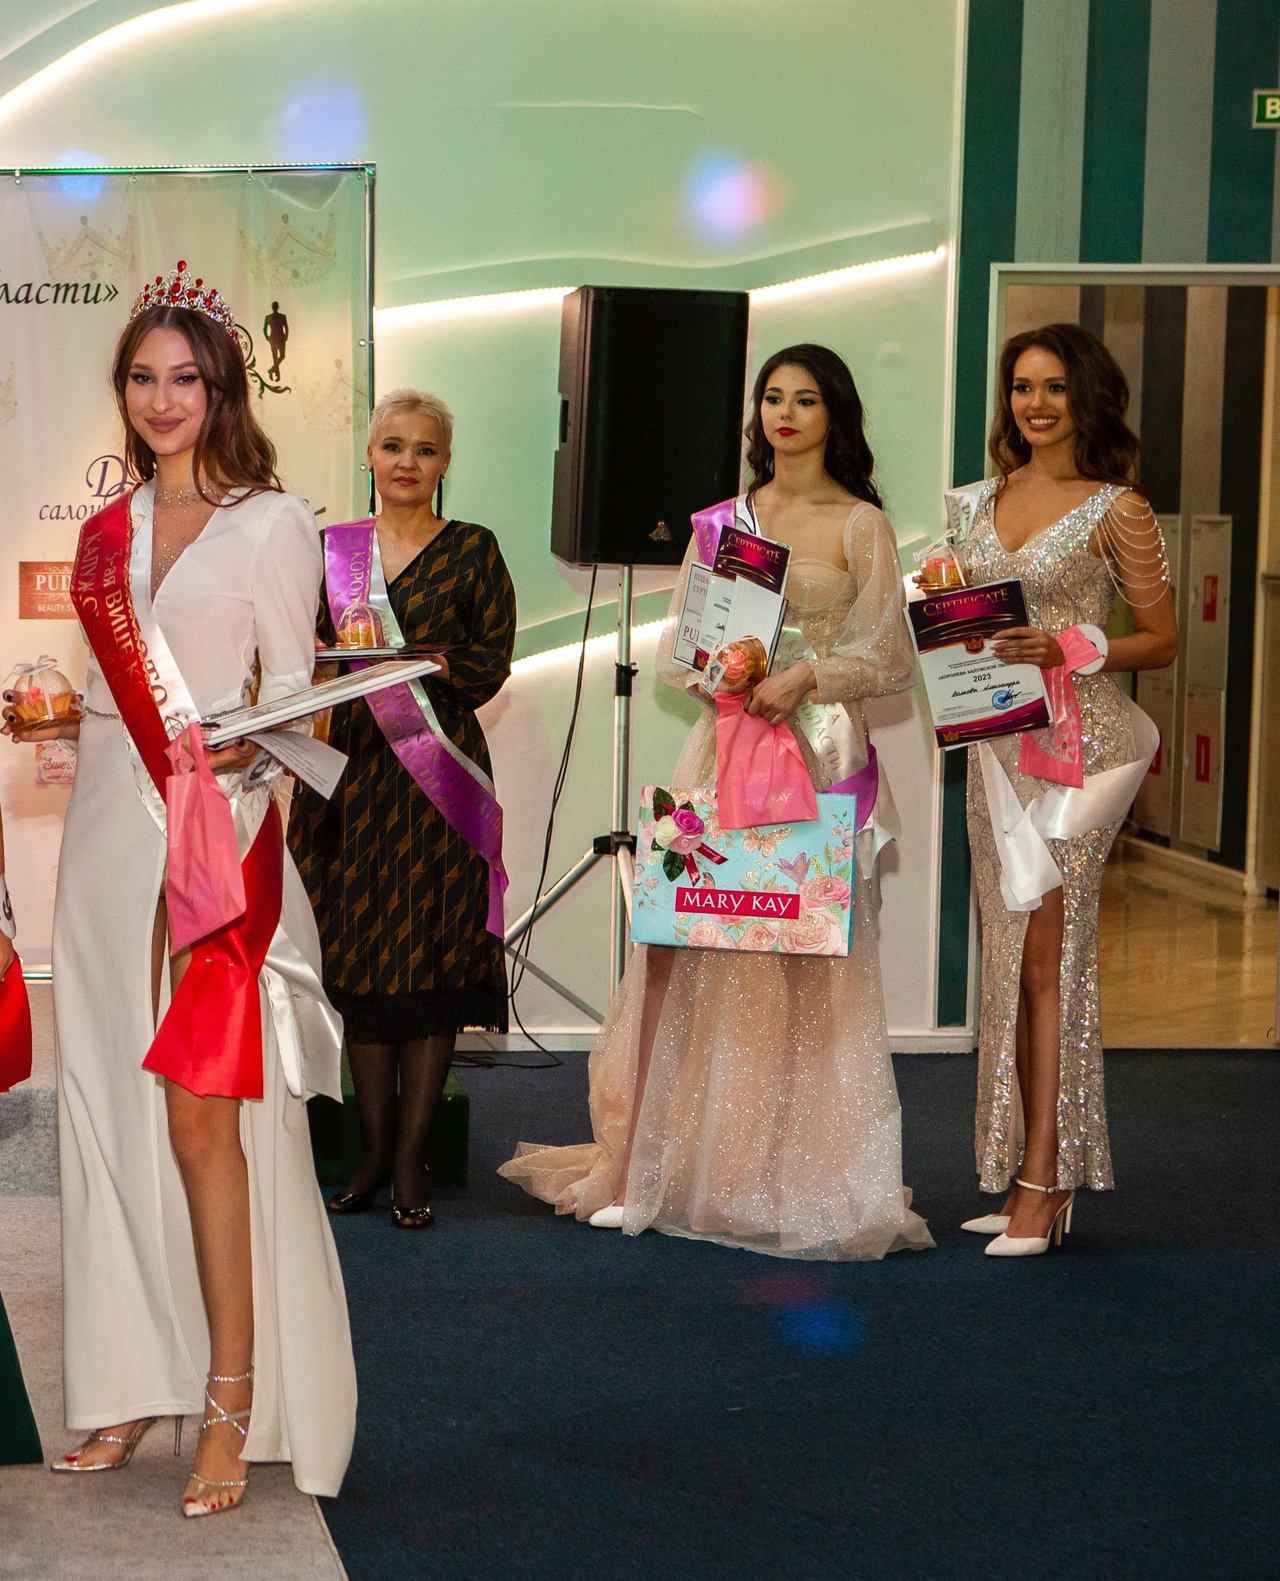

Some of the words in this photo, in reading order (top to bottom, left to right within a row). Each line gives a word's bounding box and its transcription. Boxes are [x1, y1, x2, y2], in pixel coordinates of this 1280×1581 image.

[728, 532, 781, 564] CERTIFICATE
[37, 603, 65, 612] BEAUTY
[923, 588, 1010, 617] CERTIFICATE
[105, 588, 136, 657] ВИЦЕ
[972, 672, 992, 683] 2023
[682, 891, 745, 914] MARY
[752, 895, 793, 917] KAY
